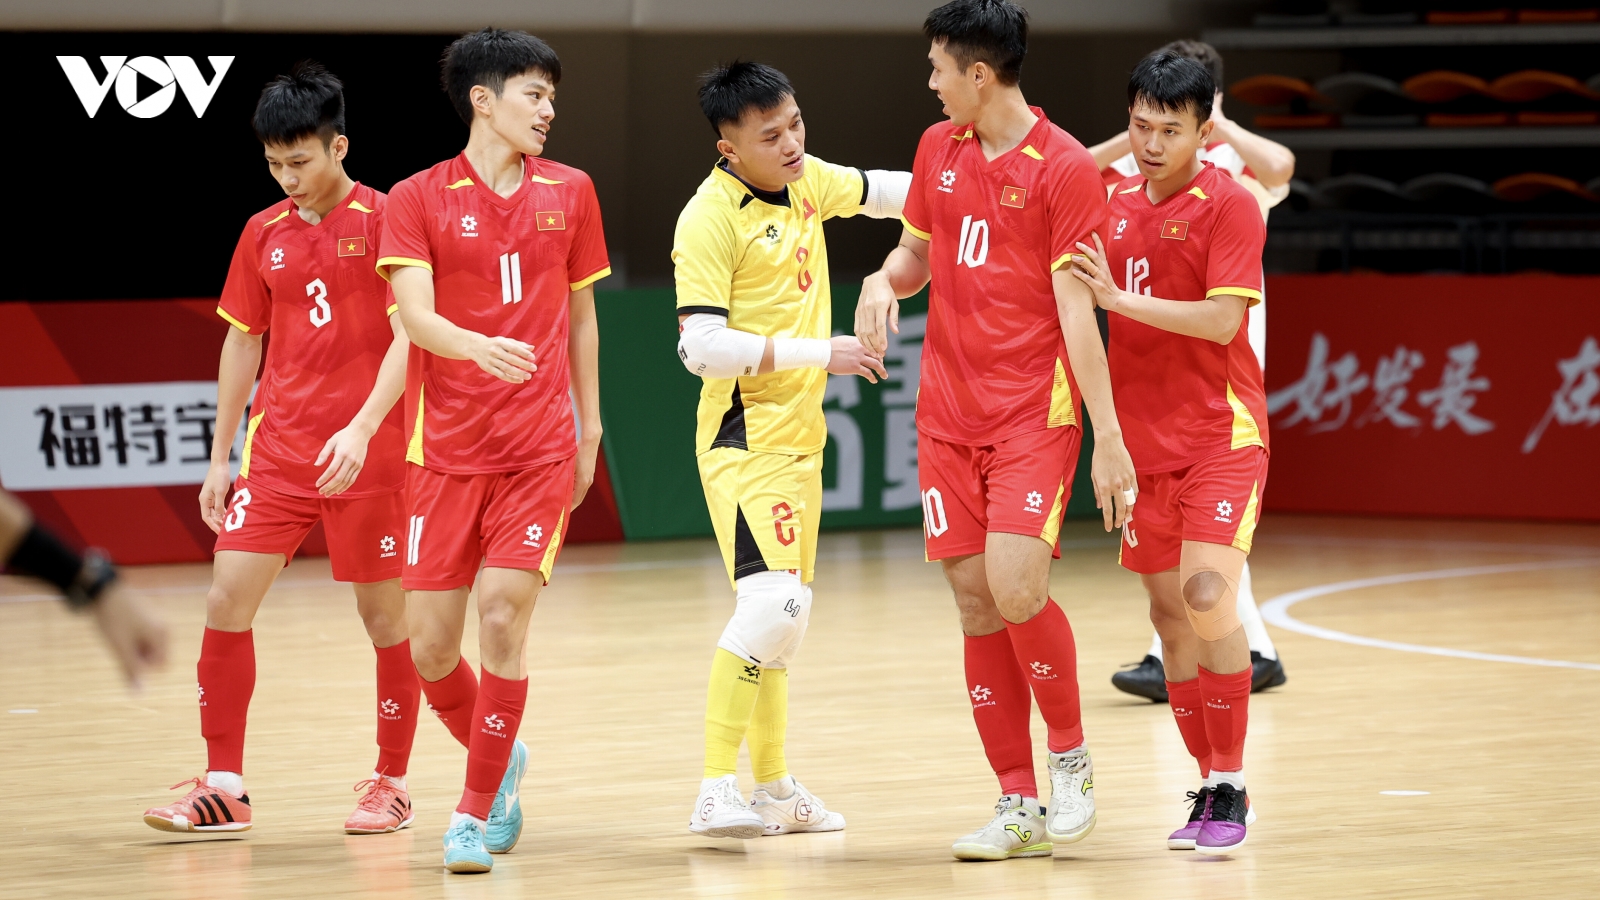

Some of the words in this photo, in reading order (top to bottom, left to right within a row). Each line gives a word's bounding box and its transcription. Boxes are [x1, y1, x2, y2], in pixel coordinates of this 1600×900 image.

[957, 214, 989, 268] 10
[499, 251, 522, 305] 11
[796, 247, 813, 293] 2
[1126, 256, 1152, 297] 12
[305, 277, 332, 329] 3
[224, 487, 252, 533] 3
[771, 501, 795, 546] 2
[921, 486, 949, 539] 10
[407, 514, 425, 567] 11
